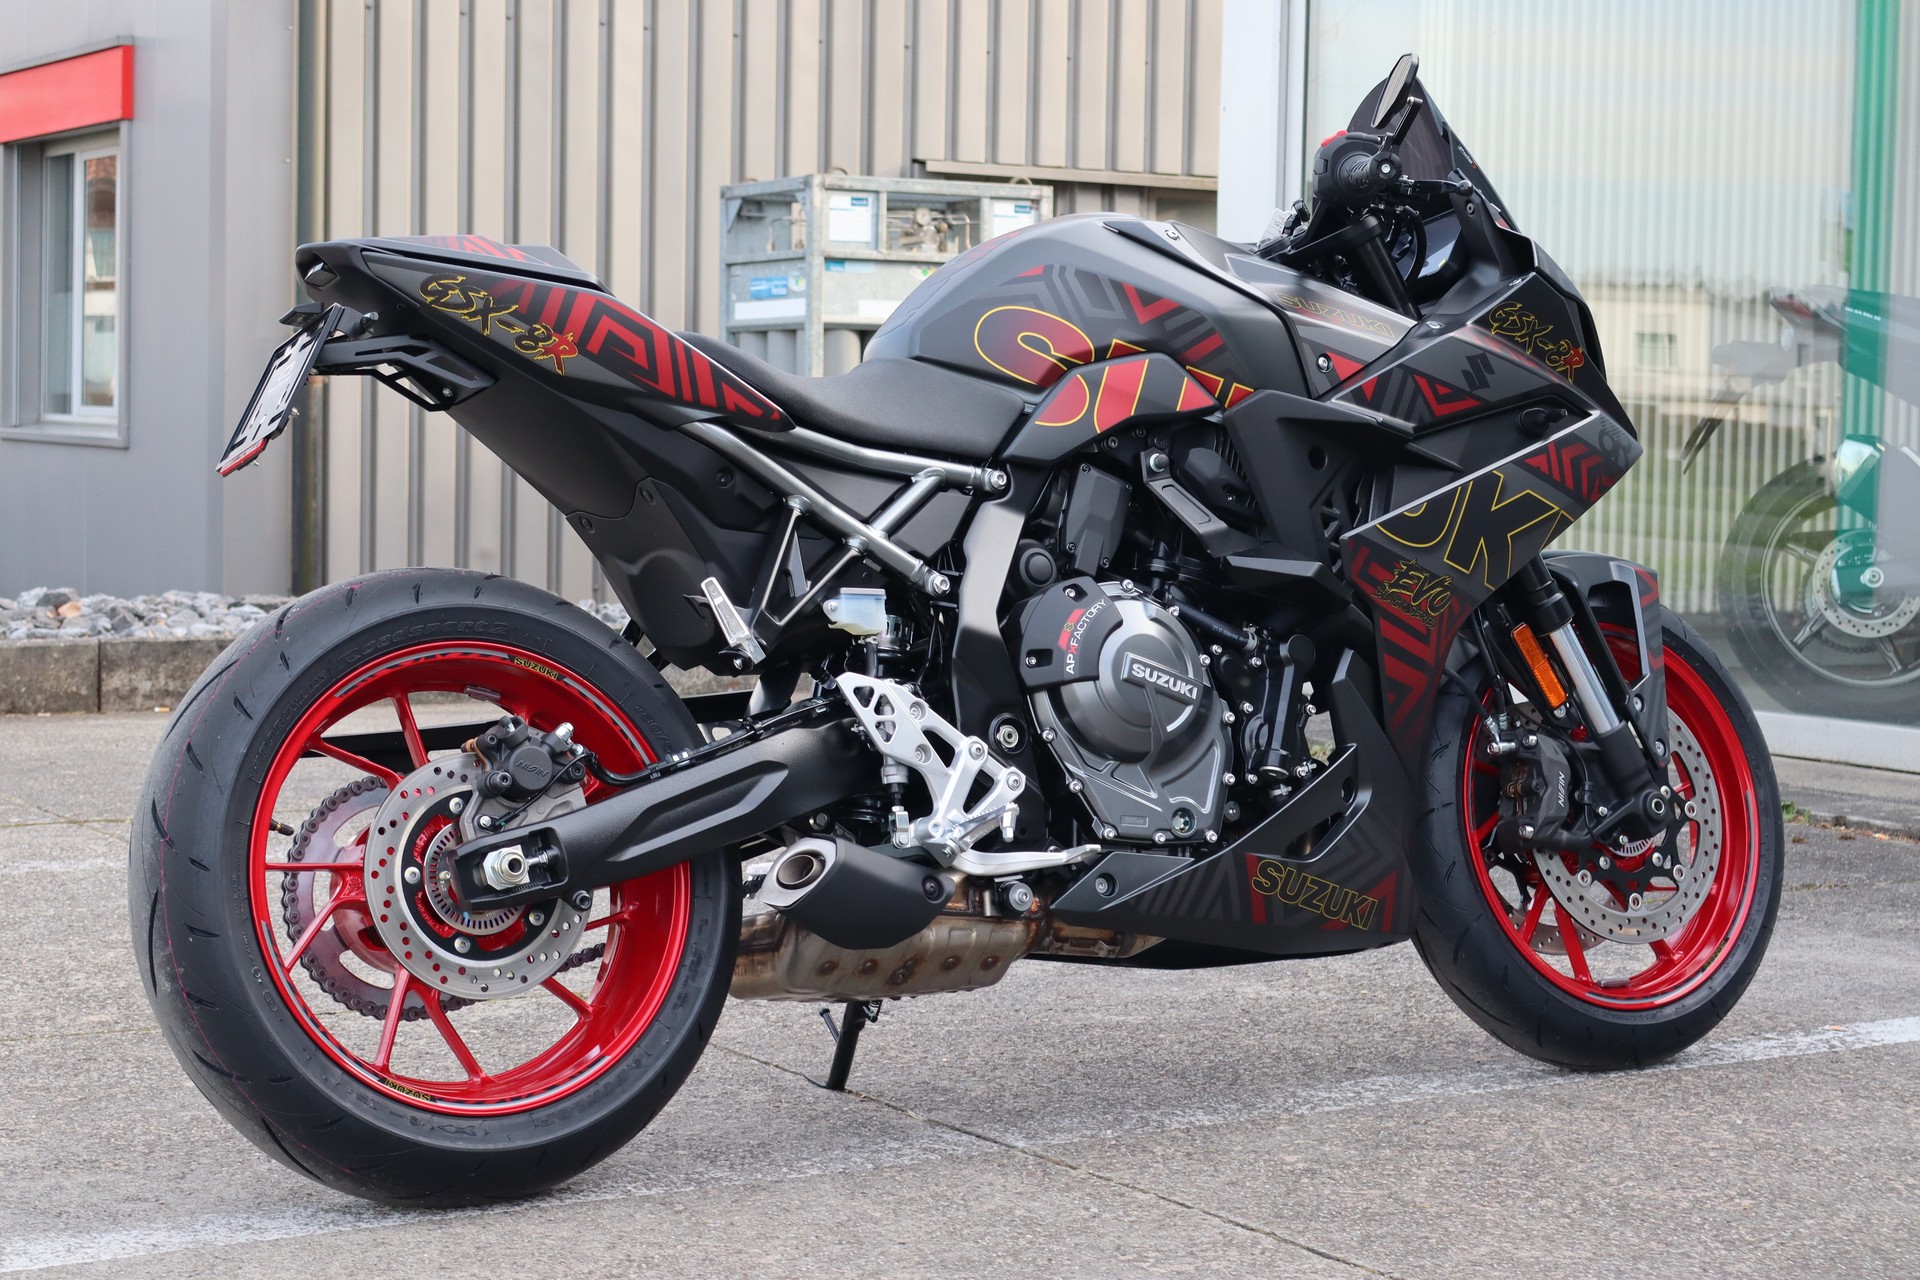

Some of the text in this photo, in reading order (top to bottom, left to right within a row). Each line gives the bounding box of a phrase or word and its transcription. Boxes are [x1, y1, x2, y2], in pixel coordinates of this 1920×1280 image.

[419, 273, 578, 376] GSX-8R
[1274, 292, 1395, 339] SUZUKI
[1489, 301, 1584, 384] GSX-8R
[1383, 559, 1453, 616] EVO
[514, 656, 559, 681] SUZUKI
[1132, 662, 1198, 700] SUZUKI
[1251, 858, 1379, 931] SUZUKI
[385, 1078, 431, 1102] SUZUKI
